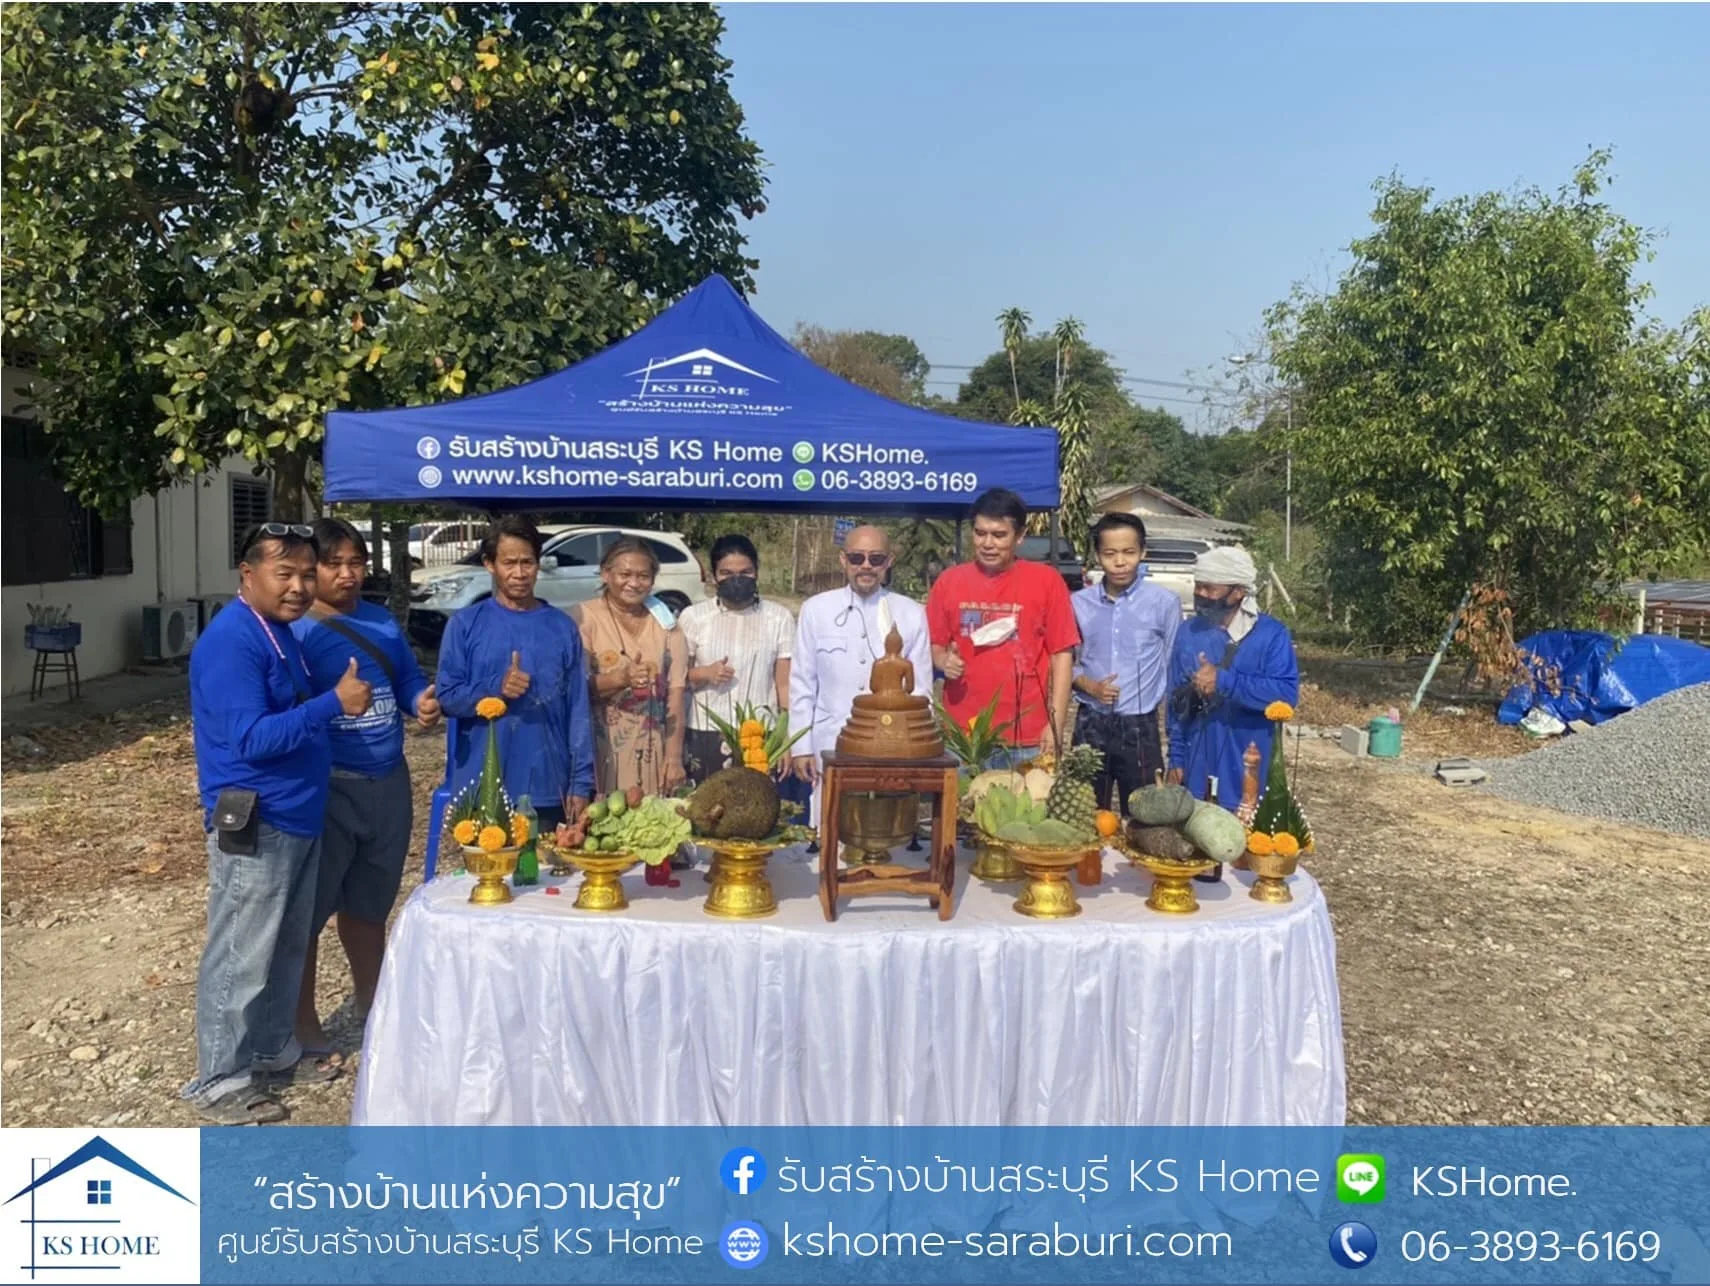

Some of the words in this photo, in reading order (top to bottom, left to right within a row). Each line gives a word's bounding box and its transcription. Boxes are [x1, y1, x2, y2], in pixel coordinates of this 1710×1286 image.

[651, 384, 679, 393] KS
[684, 384, 750, 396] HOME
[448, 434, 660, 466] รับสร้างบ้านสระบุรี
[669, 439, 703, 461] KS
[713, 440, 783, 463] Home
[822, 442, 929, 465] KSHome.
[451, 465, 783, 489] www.kshome-saraburi.com
[821, 469, 978, 492] 06-3893-6169
